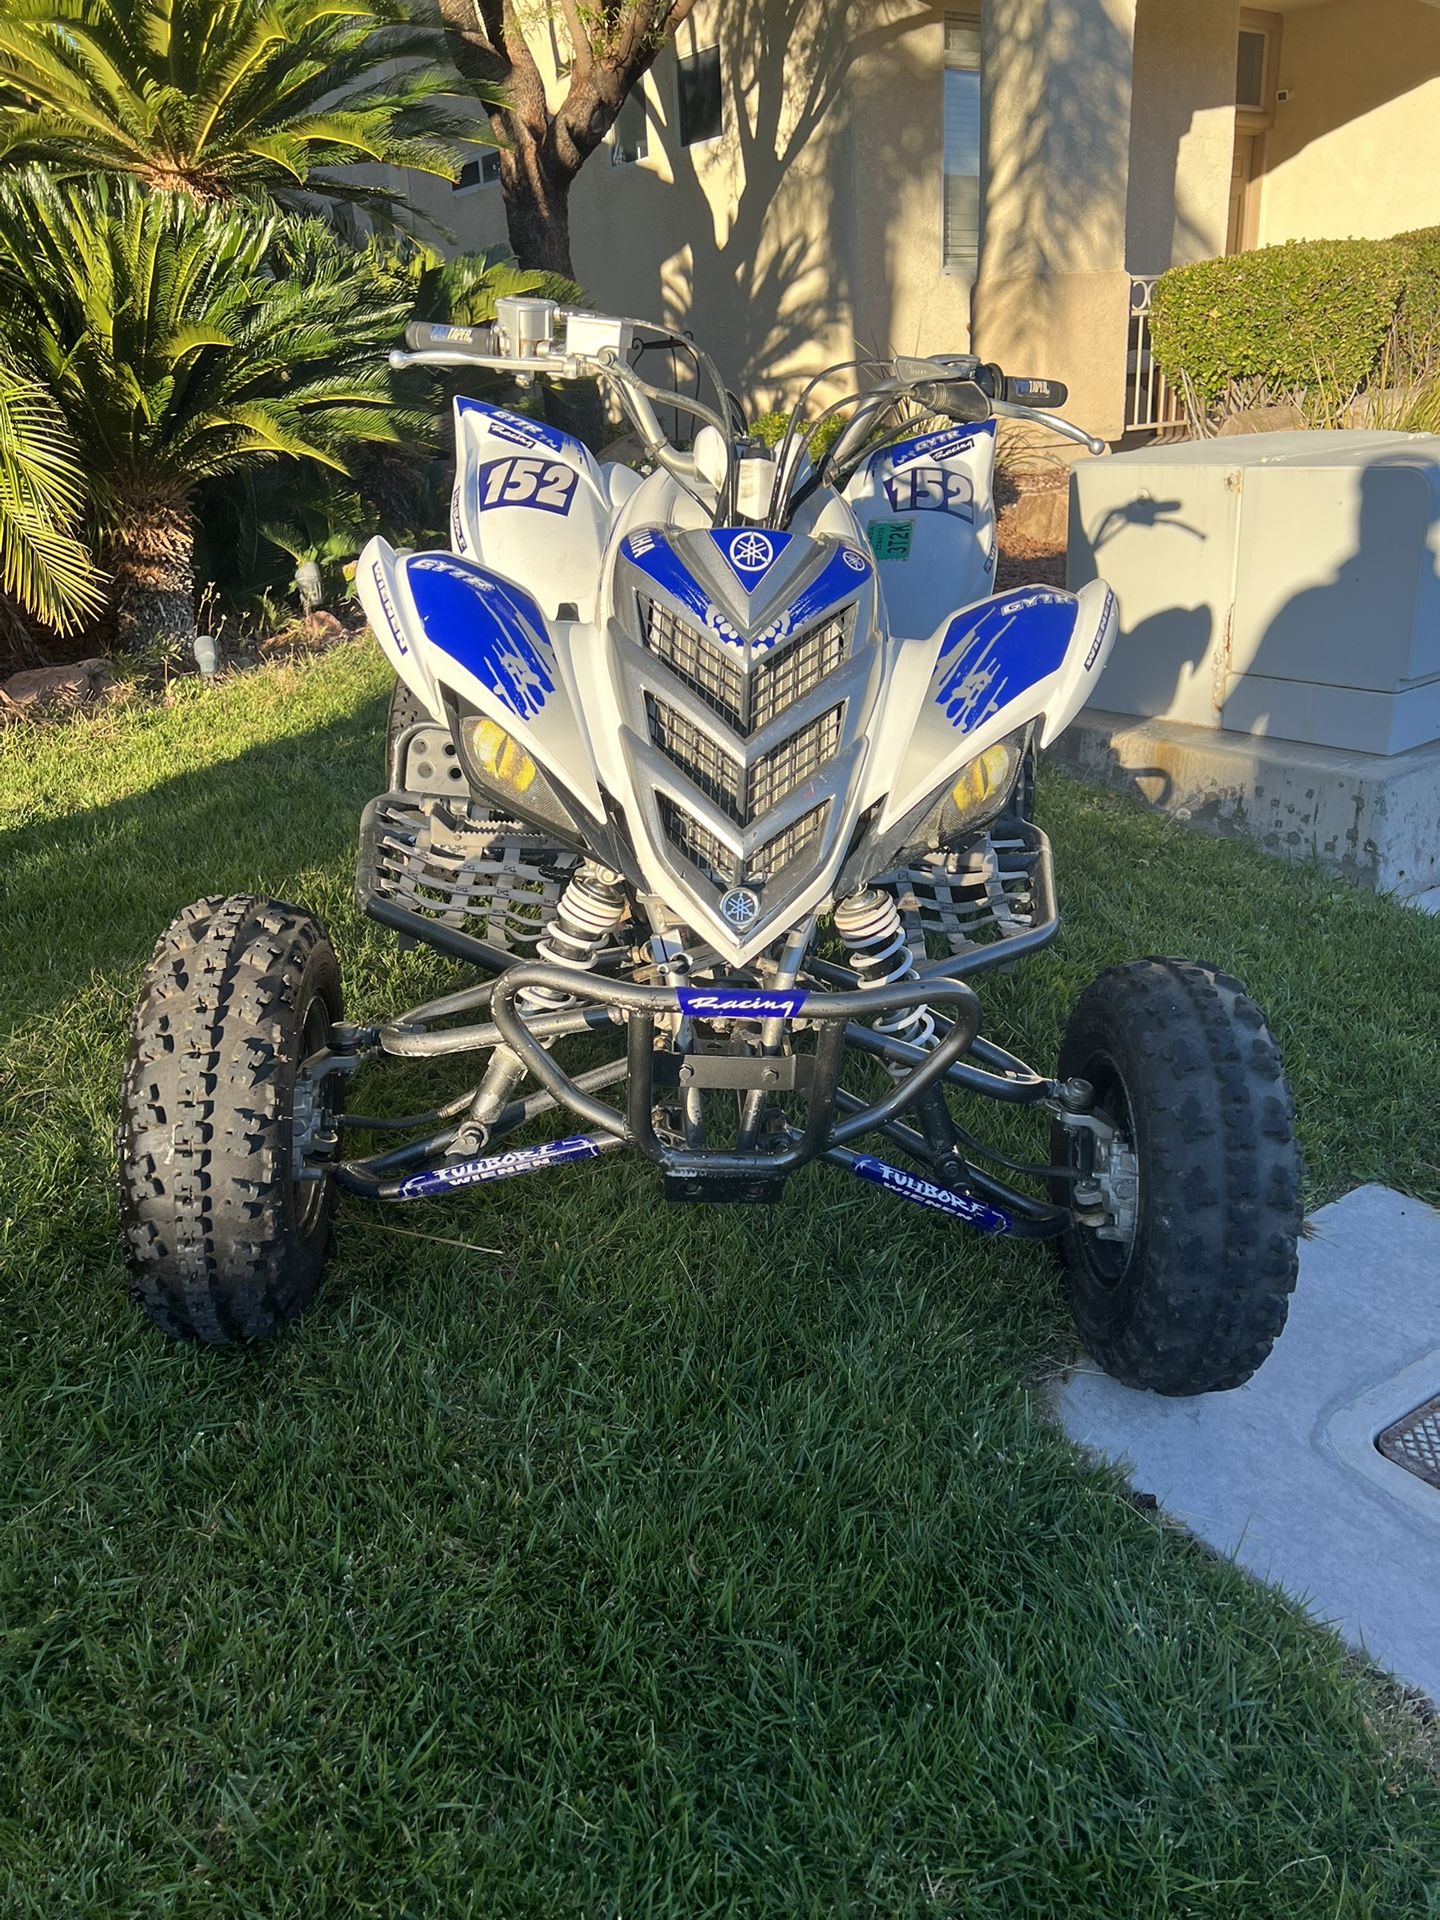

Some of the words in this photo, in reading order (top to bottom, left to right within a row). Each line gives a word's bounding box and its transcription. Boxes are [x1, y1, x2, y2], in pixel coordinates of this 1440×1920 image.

[490, 424, 535, 448] Racing
[491, 411, 544, 434] GYTR
[914, 430, 961, 452] GYTR
[932, 438, 975, 460] Racing
[484, 459, 574, 508] 152
[892, 469, 973, 522] 152
[409, 559, 496, 592] GYTR
[687, 997, 794, 1018] Racing
[449, 1157, 551, 1187] WIENEN
[884, 1182, 973, 1221] WIENEN
